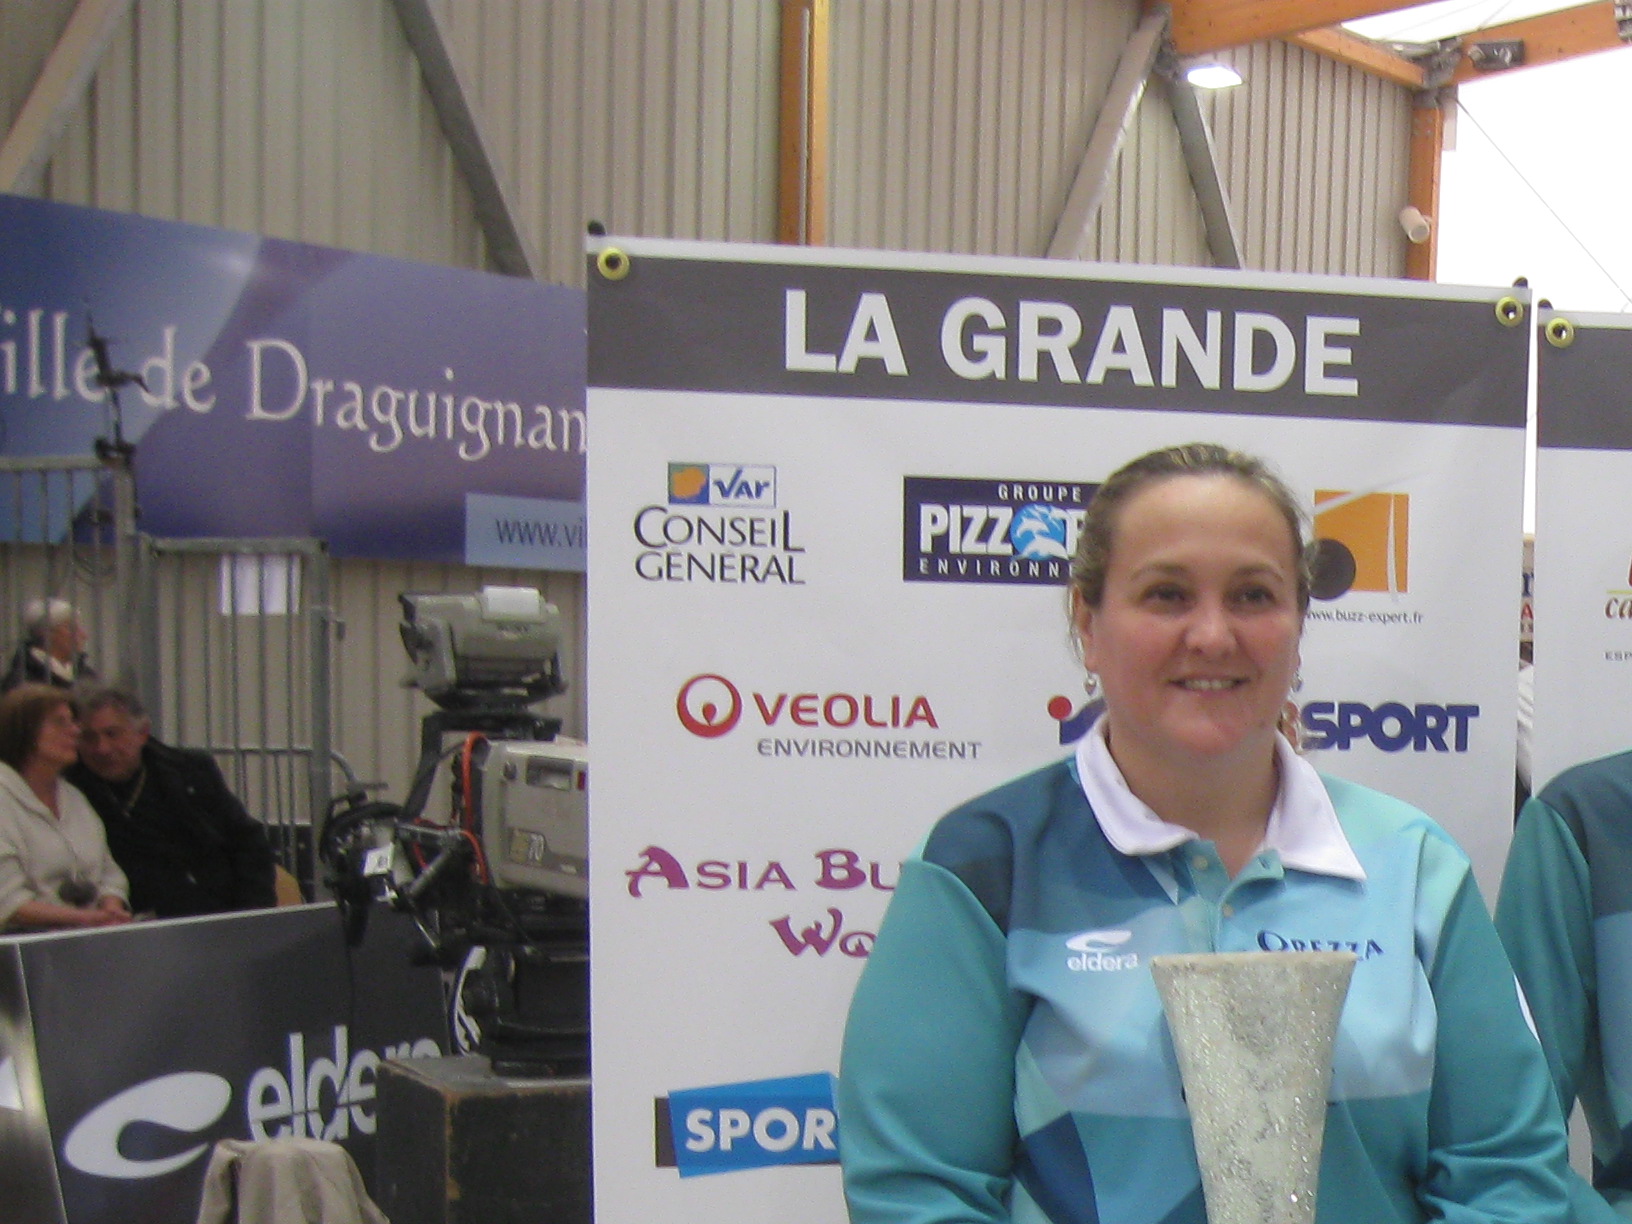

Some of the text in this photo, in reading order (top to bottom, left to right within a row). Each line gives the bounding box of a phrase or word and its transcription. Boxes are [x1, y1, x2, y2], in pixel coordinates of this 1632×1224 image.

[785, 289, 1361, 398] LA GRANDE
[1, 309, 586, 462] ille de Draguignan
[998, 483, 1082, 503] GROUPE
[919, 558, 1073, 579] ENVIRONN
[752, 692, 939, 730] VEOLIA
[1300, 700, 1480, 754] SPORT
[757, 738, 982, 760] ENVIRONNEMENT
[625, 845, 797, 899] ASIA
[769, 907, 878, 959] WO
[1067, 950, 1138, 973] eldera
[686, 1105, 838, 1152] SPOR
